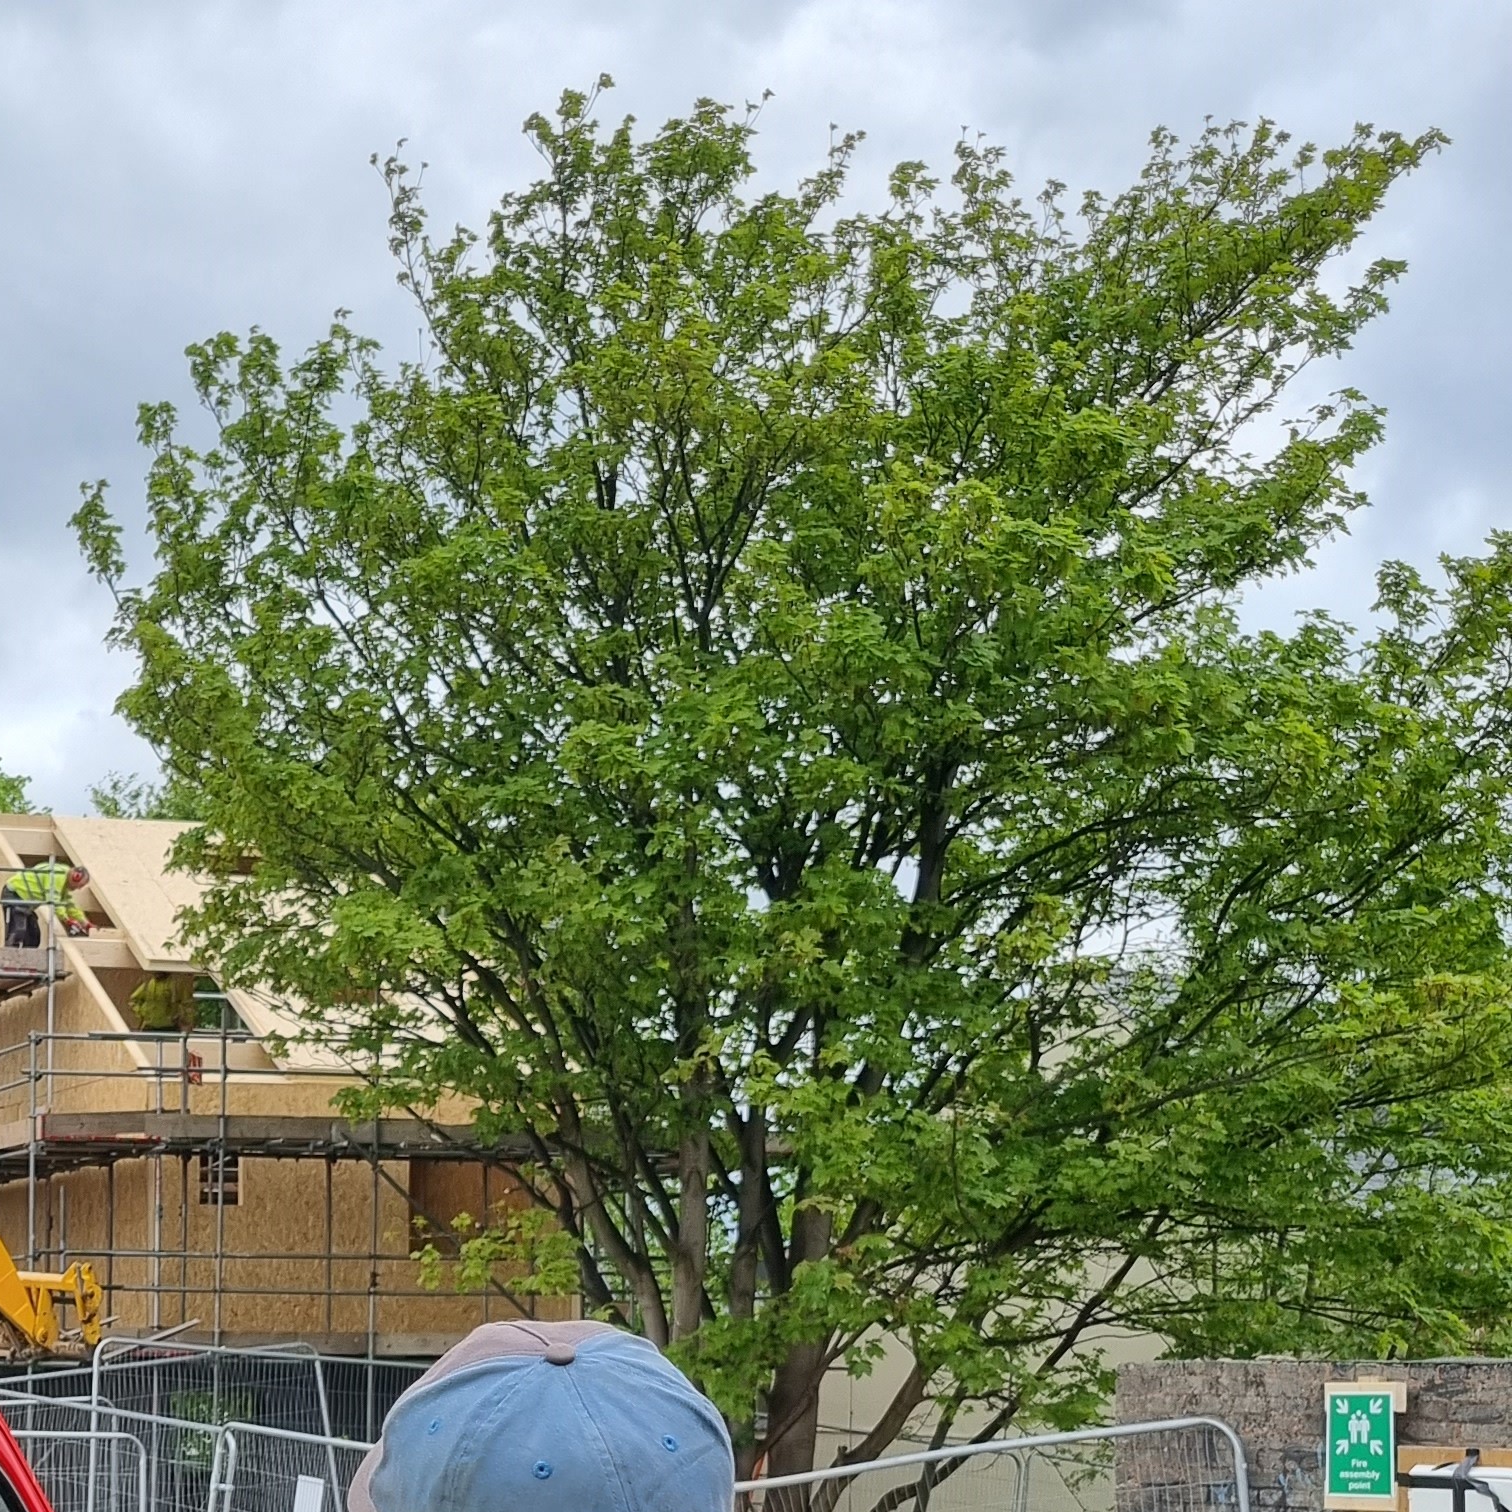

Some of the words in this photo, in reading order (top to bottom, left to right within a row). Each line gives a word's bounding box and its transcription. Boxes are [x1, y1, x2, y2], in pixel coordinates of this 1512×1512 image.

[1351, 1459, 1368, 1468] Fire
[1339, 1470, 1381, 1481] assembly
[1348, 1482, 1371, 1491] point
